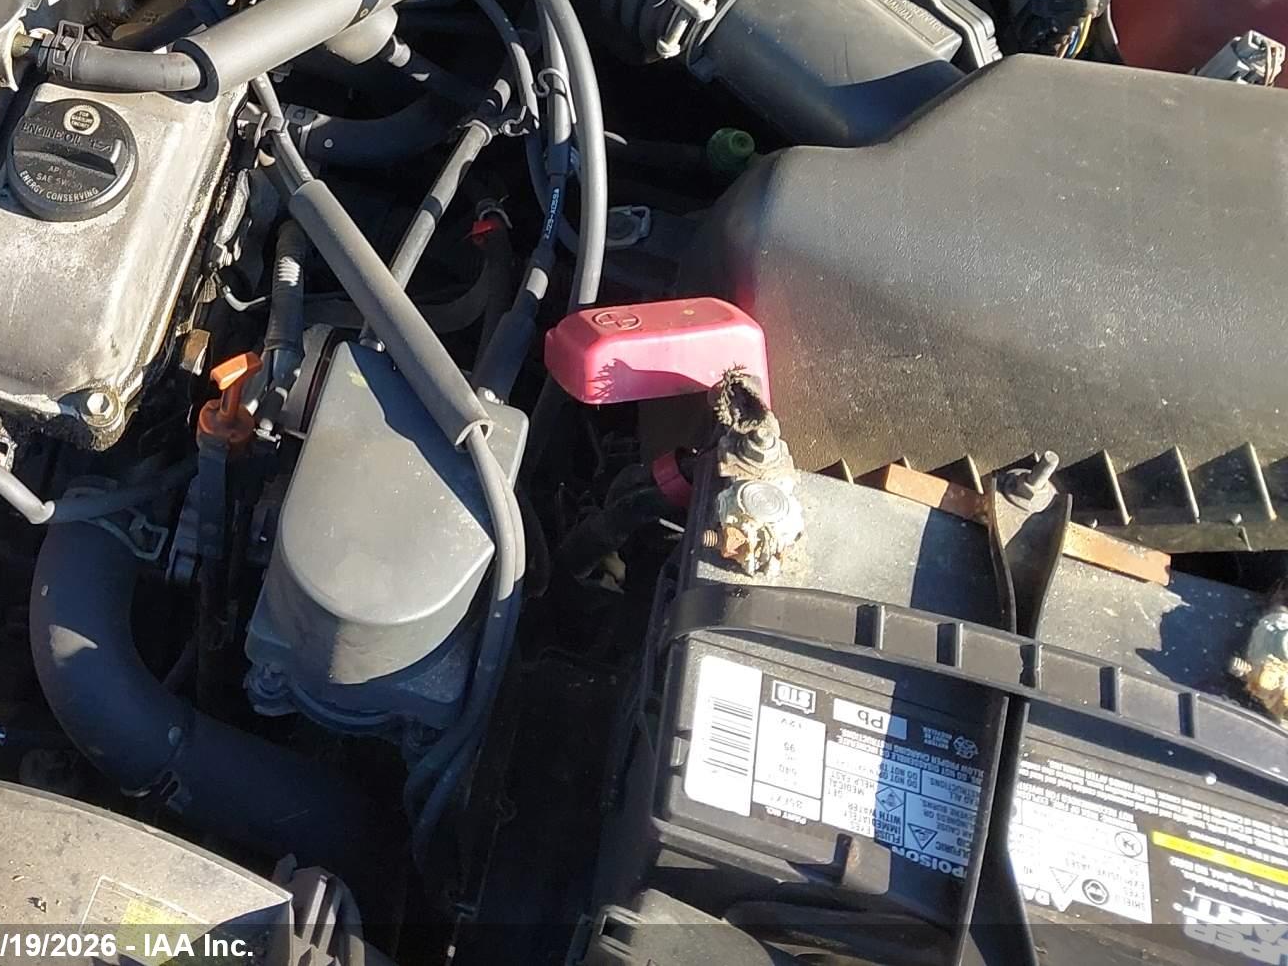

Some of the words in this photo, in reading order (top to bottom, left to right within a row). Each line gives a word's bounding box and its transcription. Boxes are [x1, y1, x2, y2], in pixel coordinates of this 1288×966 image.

[35, 172, 53, 184] SAE
[19, 170, 44, 195] ENERGY
[46, 187, 100, 202] CONSERVING
[857, 710, 884, 730] Pb
[906, 770, 918, 781] DO
[906, 779, 918, 789] DO
[782, 810, 806, 824] PART
[878, 810, 901, 825] WITH
